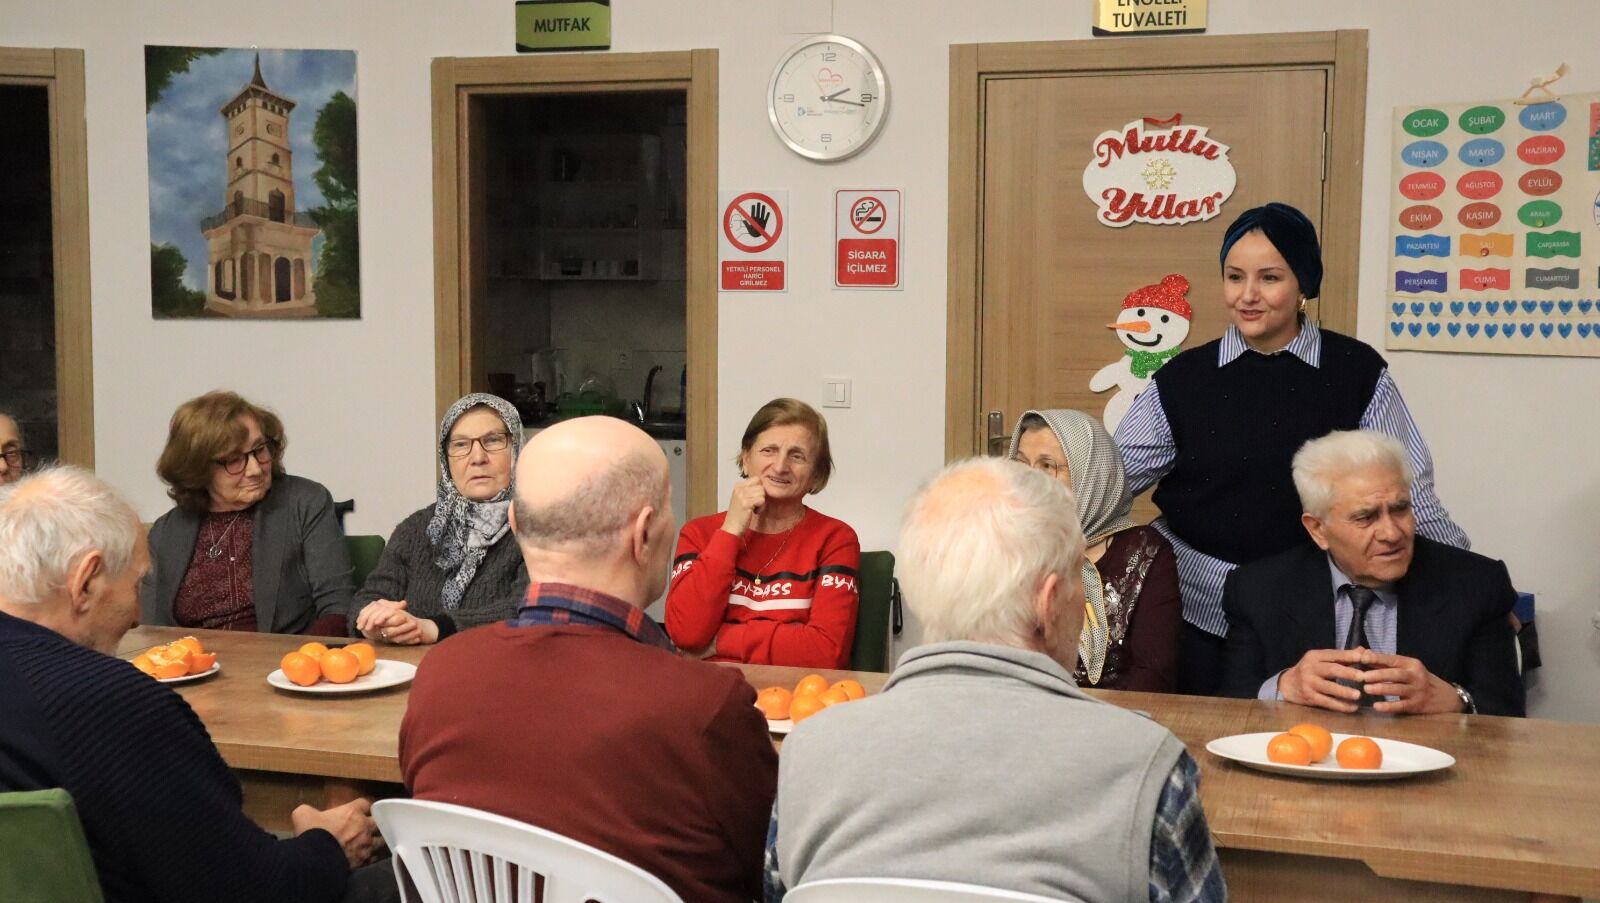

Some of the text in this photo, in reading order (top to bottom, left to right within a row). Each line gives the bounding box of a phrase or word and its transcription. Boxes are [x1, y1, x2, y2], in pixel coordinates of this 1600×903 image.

[1112, 5, 1187, 28] TUVALETİ
[534, 17, 591, 32] MUTFAK
[822, 52, 837, 62] 12
[860, 93, 873, 103] 3
[1468, 115, 1496, 127] ŞUBAT
[1529, 112, 1557, 121] MART
[1412, 118, 1440, 129] OCAK
[1096, 127, 1220, 169] Mutlu
[1468, 147, 1496, 157] MAYIS
[1407, 182, 1438, 191] TEMMUZ
[1466, 211, 1495, 221] KASIM
[848, 249, 886, 260] SİGARA
[847, 263, 887, 274] İÇİLMEZ
[1404, 278, 1438, 287] PERŞEMBE
[1474, 276, 1497, 284] CUMA
